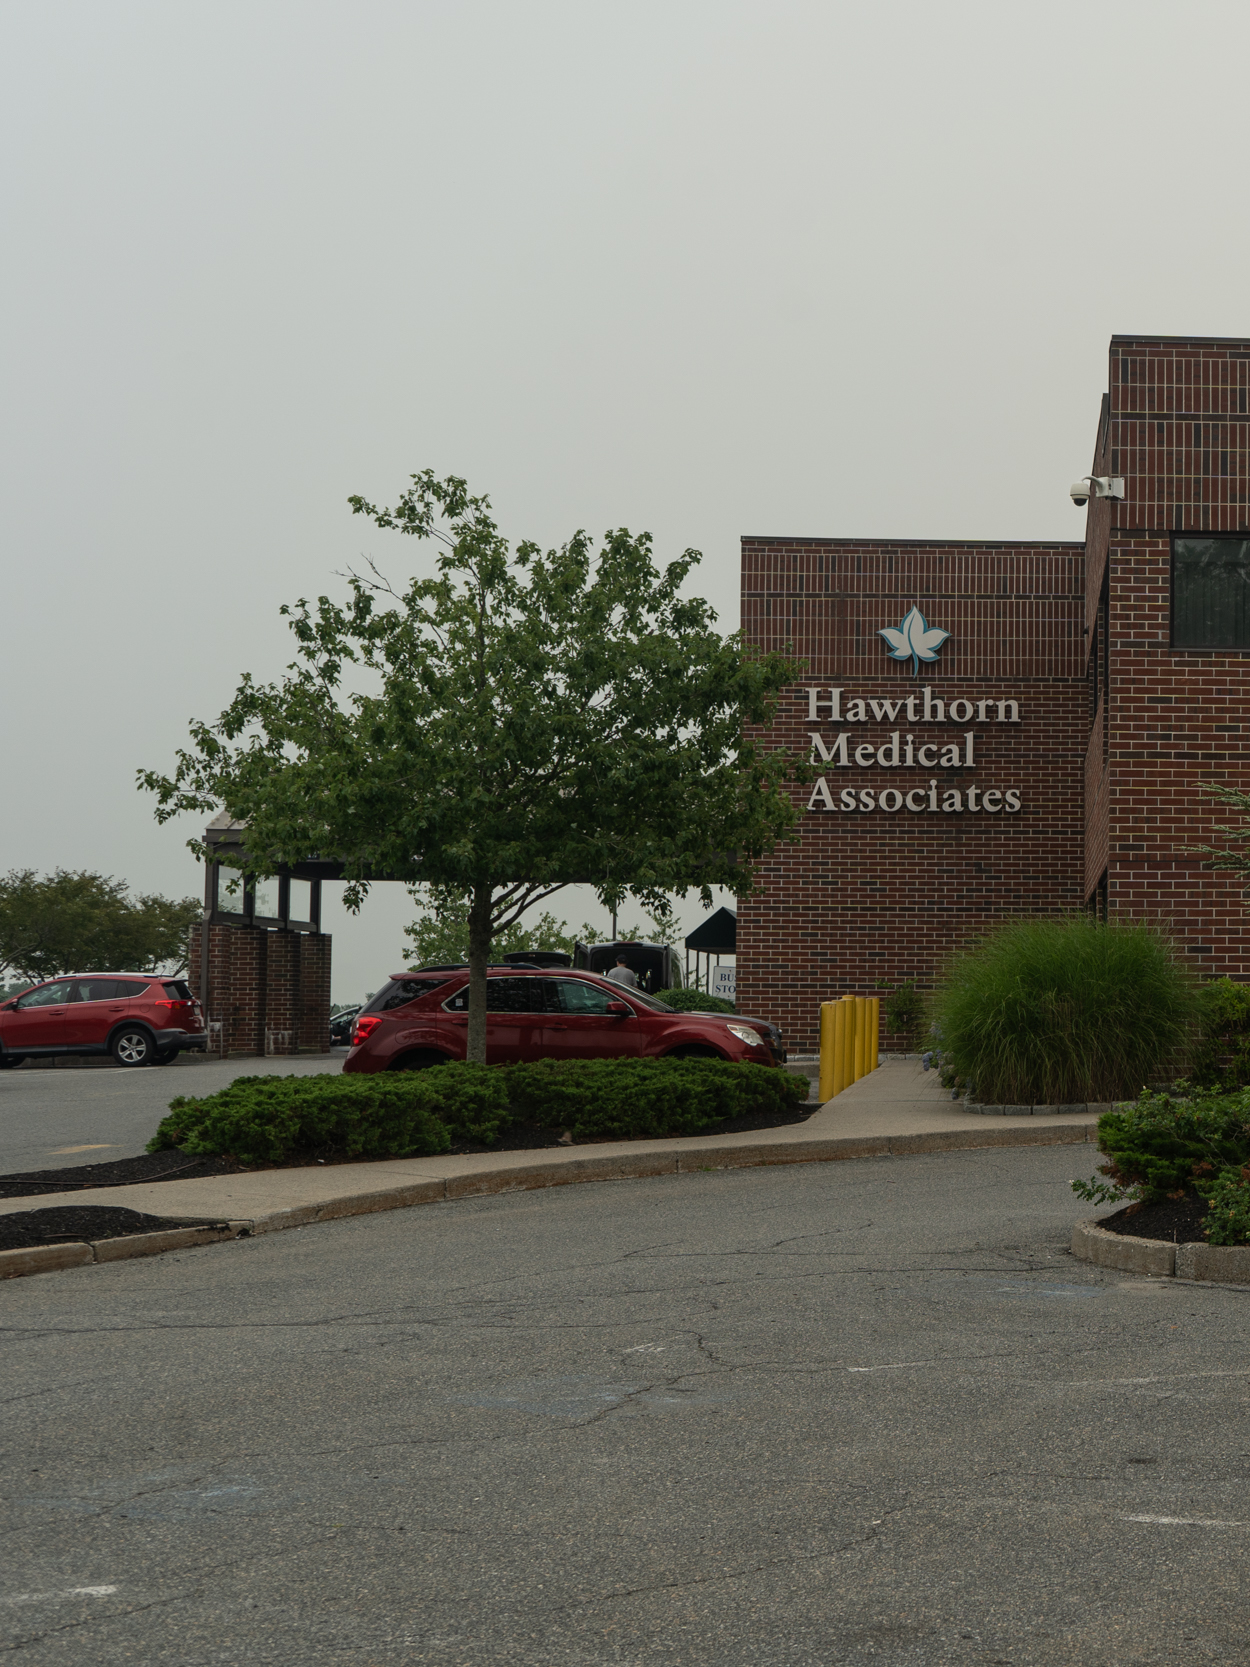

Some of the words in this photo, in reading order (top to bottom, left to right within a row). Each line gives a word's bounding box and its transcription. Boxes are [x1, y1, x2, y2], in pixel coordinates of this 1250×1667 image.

[805, 686, 1021, 722] Hawthorn
[808, 731, 976, 767] Medical
[807, 777, 1022, 812] Associates
[715, 985, 736, 993] STO
